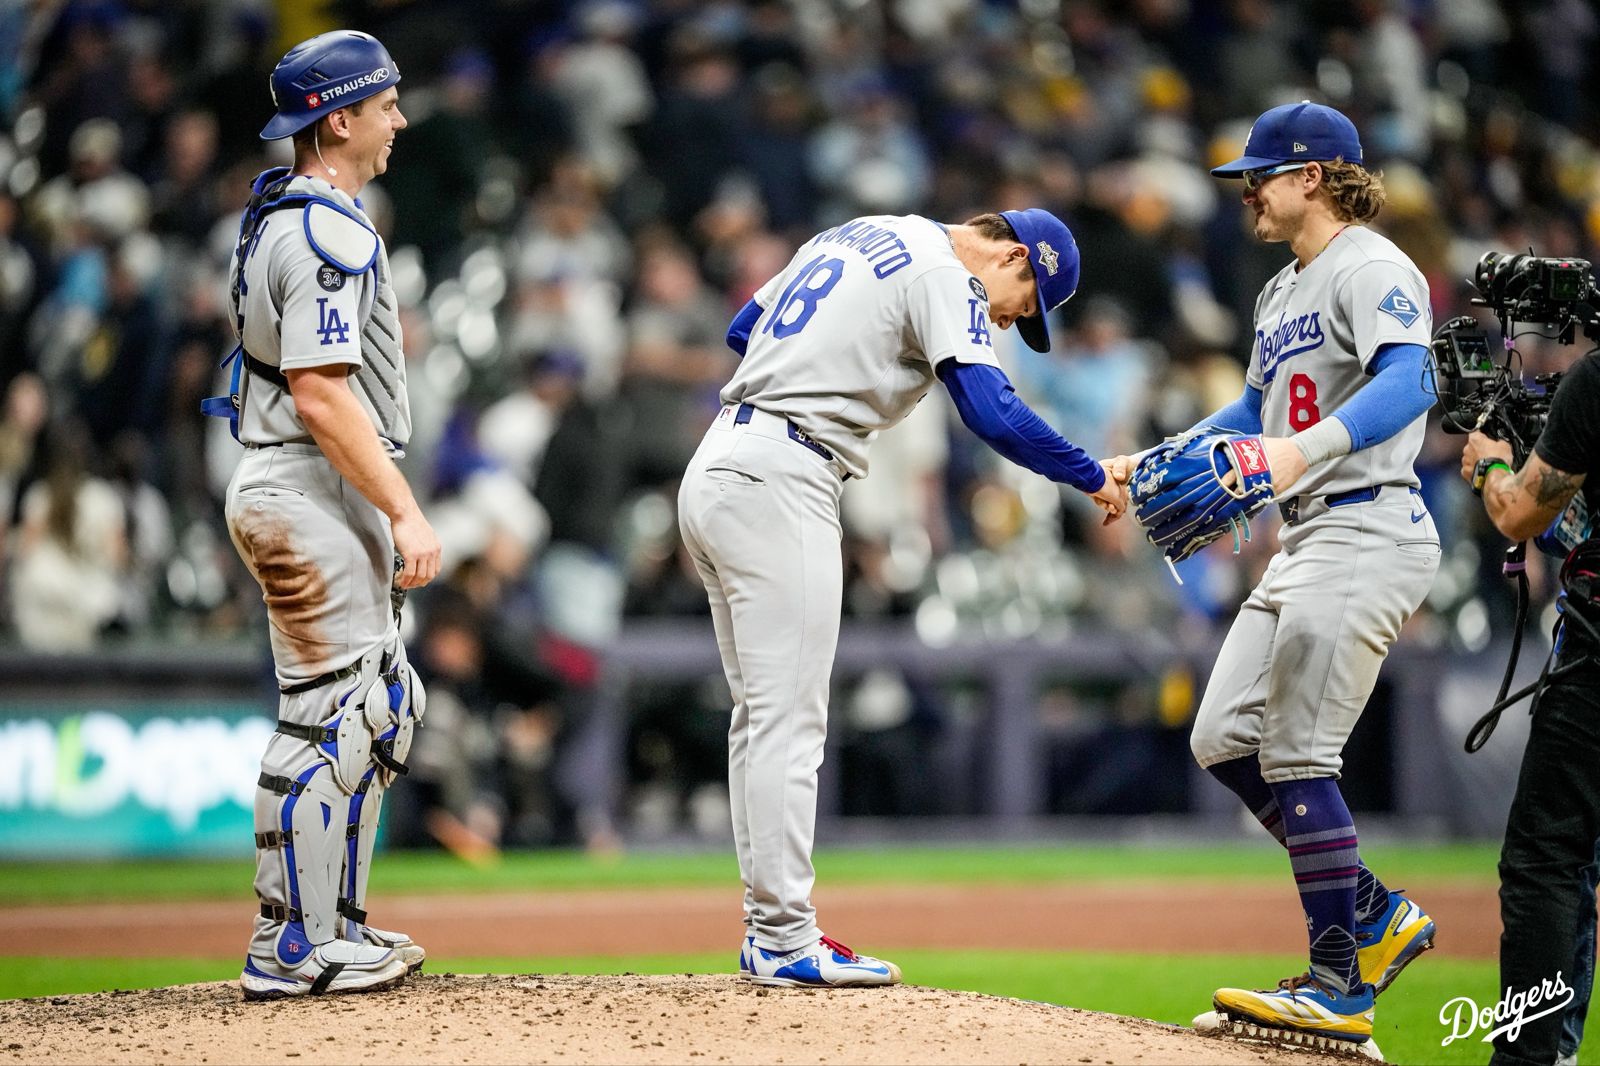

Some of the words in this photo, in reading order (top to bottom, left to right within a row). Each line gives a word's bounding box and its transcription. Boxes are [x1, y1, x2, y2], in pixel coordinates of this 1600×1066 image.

[320, 74, 371, 102] STRAUSS
[323, 272, 341, 287] 34
[762, 253, 845, 340] 18
[316, 297, 350, 346] LA
[967, 298, 992, 347] LA
[1288, 373, 1321, 433] 8
